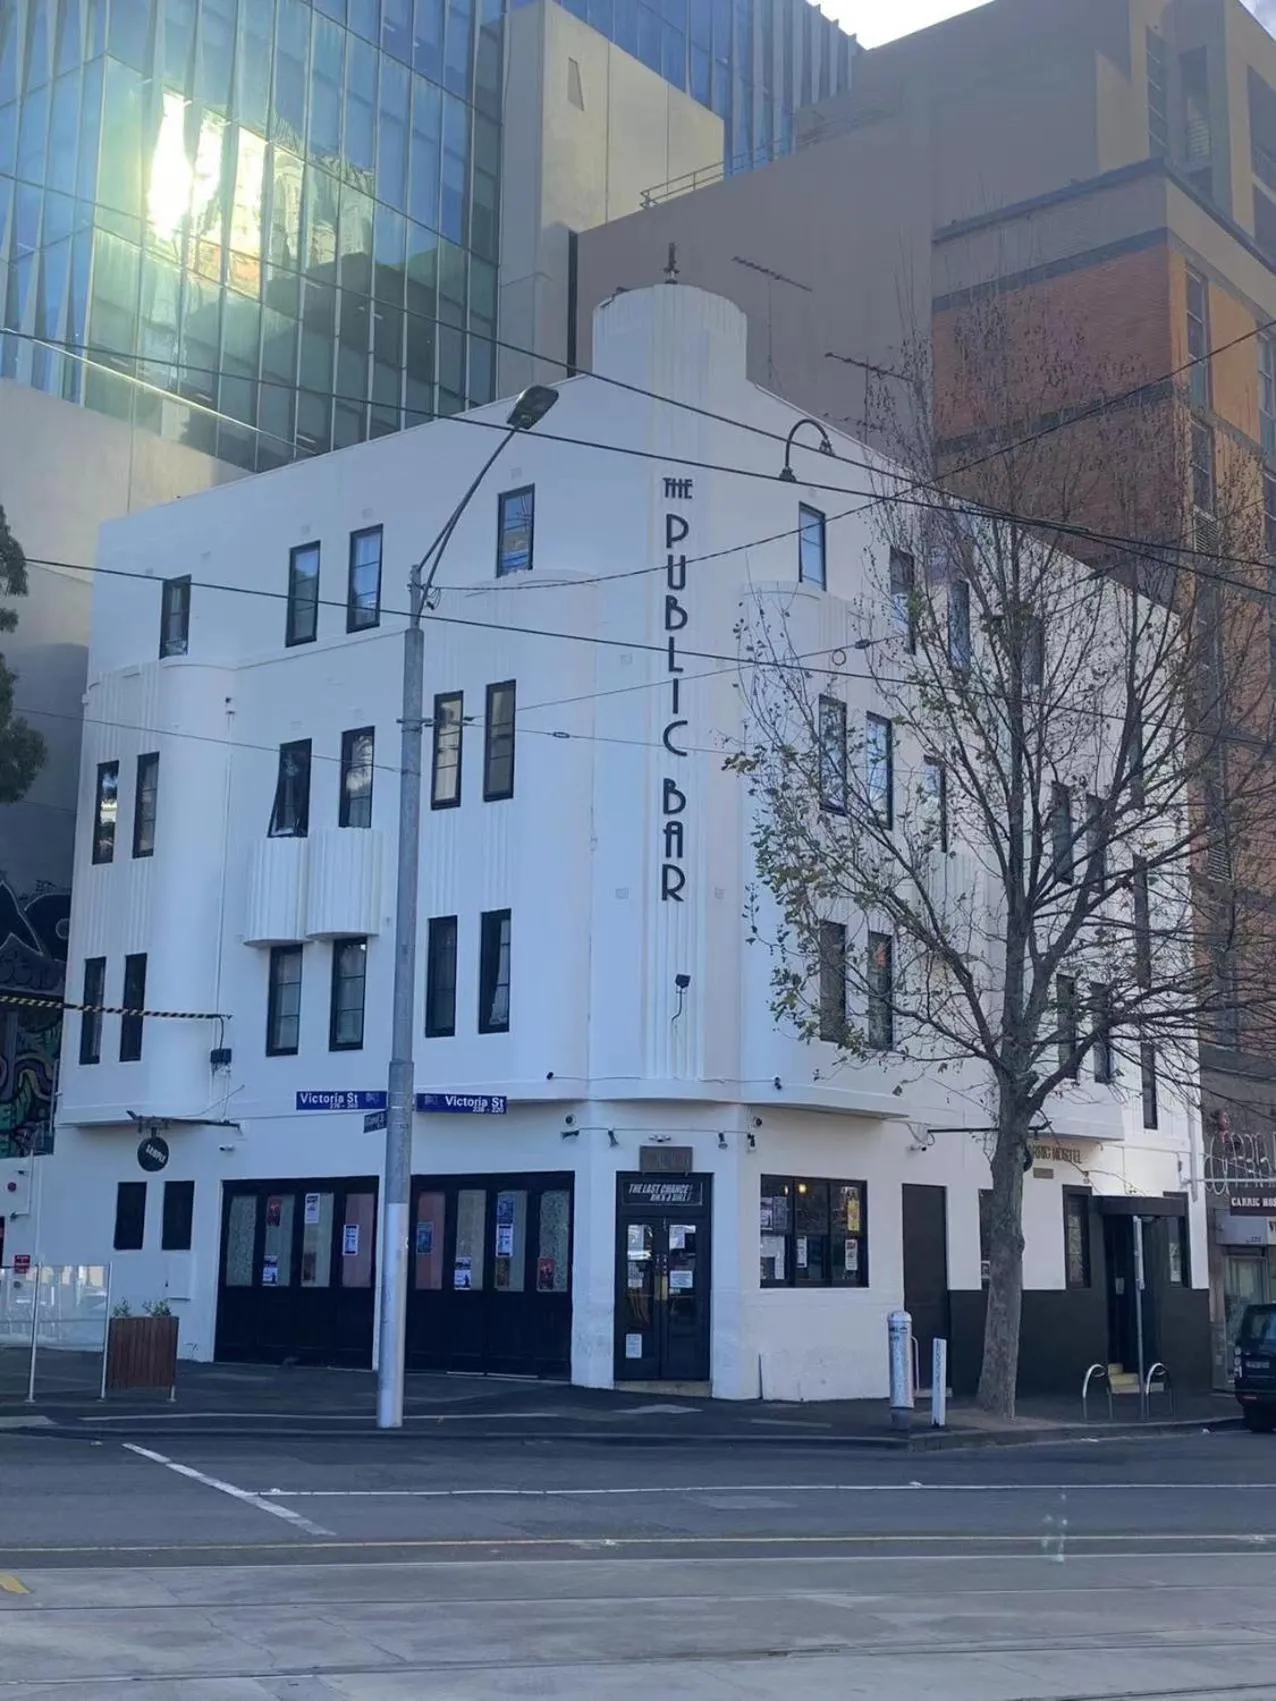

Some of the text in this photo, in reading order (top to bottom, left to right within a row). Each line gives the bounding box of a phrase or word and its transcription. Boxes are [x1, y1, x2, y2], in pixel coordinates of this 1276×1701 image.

[663, 477, 693, 499] THE
[662, 513, 690, 757] PUBLIC
[661, 777, 687, 902] BAR
[299, 1092, 358, 1105] Victoria St
[444, 1095, 504, 1109] Victoria St
